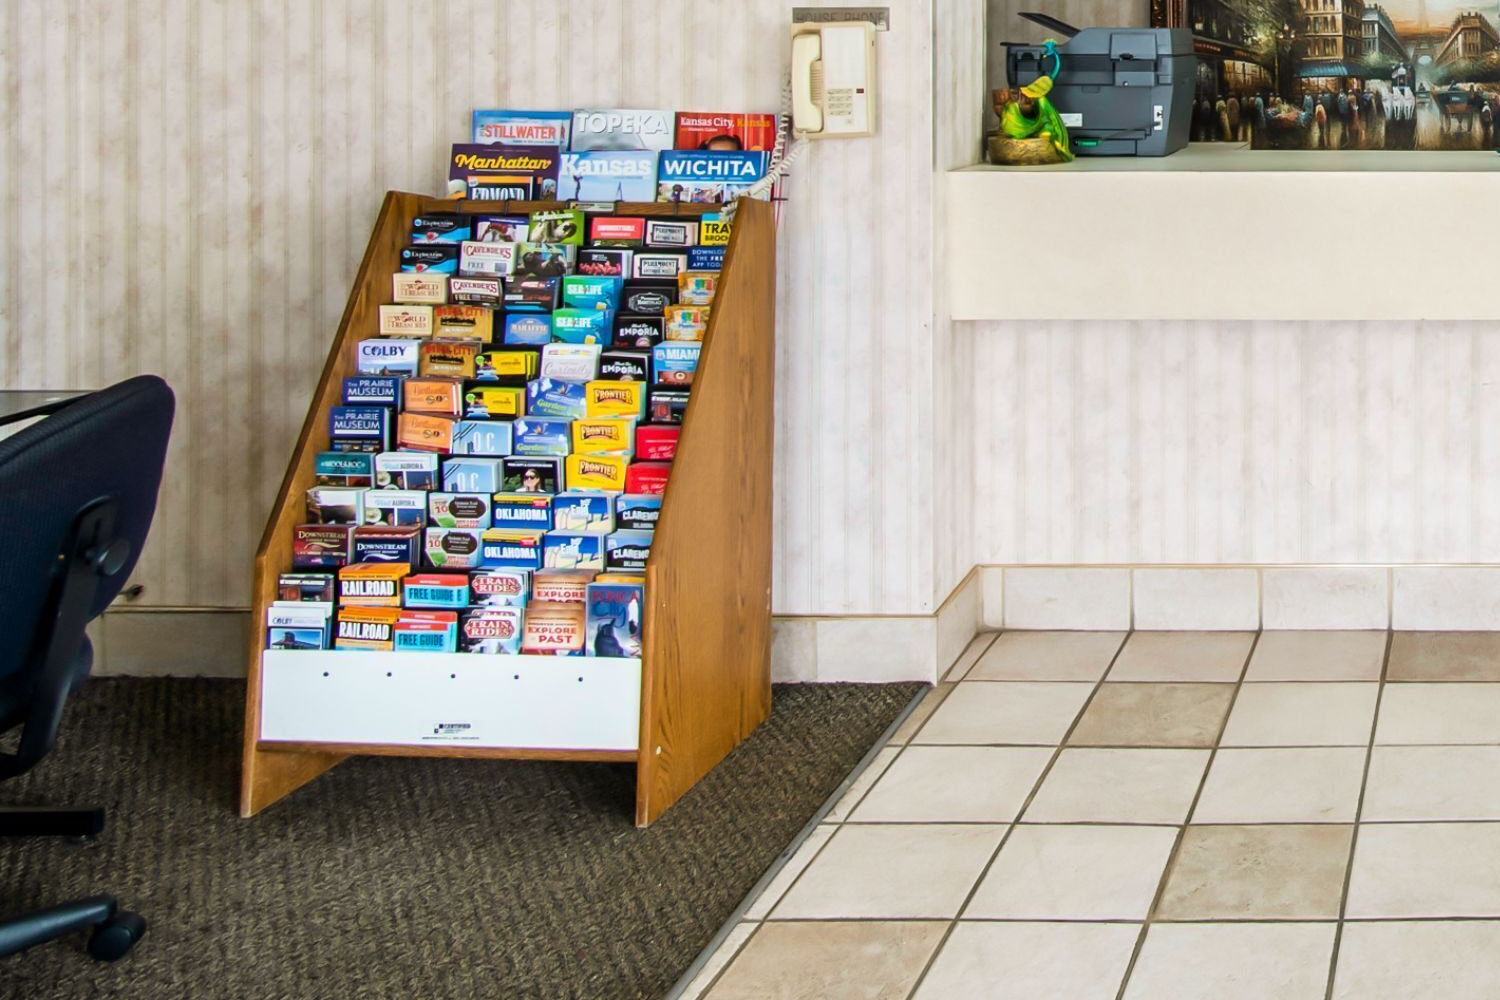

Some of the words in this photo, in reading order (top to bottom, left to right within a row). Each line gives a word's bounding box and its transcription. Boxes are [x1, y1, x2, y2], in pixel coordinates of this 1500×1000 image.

[844, 11, 885, 21] PHONE
[577, 111, 669, 135] TOPEKA
[680, 117, 712, 127] Kansas
[713, 118, 735, 128] City,
[484, 125, 556, 139] STILLWATER
[454, 154, 552, 170] Manhattan
[560, 154, 651, 176] Kansas
[664, 160, 757, 176] WICHITA
[466, 244, 512, 259] CAVENDER'S
[453, 281, 498, 294] CAVENDER'S
[620, 327, 659, 336] EMPORIA
[362, 345, 407, 357] COLBY
[602, 365, 643, 375] EMPORIA
[359, 379, 394, 387] PRAIRIE
[347, 387, 395, 396] MUSEUM
[594, 388, 633, 405] FRONTIER
[345, 412, 380, 420] PRAIRIE
[334, 420, 380, 429] MUSEUM
[580, 424, 619, 440] FRONTIER
[578, 460, 618, 480] FRONTIER
[495, 507, 548, 521] OKLAHOMA
[298, 530, 347, 539] DOWNSTREAM
[357, 543, 407, 551] DOWNSTREAM
[484, 546, 537, 559] OKLAHOMA
[478, 576, 517, 585] TRAIN
[341, 580, 395, 596] RAILROAD
[408, 587, 429, 600] FREE
[478, 584, 518, 593] RIDES
[537, 590, 586, 598] EXPLORE
[469, 620, 511, 629] TRAIN
[527, 626, 577, 634] EXPLORE
[338, 621, 390, 640] RAILROAD
[469, 627, 512, 637] RIDES
[398, 633, 419, 646] FREE
[420, 634, 444, 647] GUIDE
[538, 635, 573, 644] PAST
